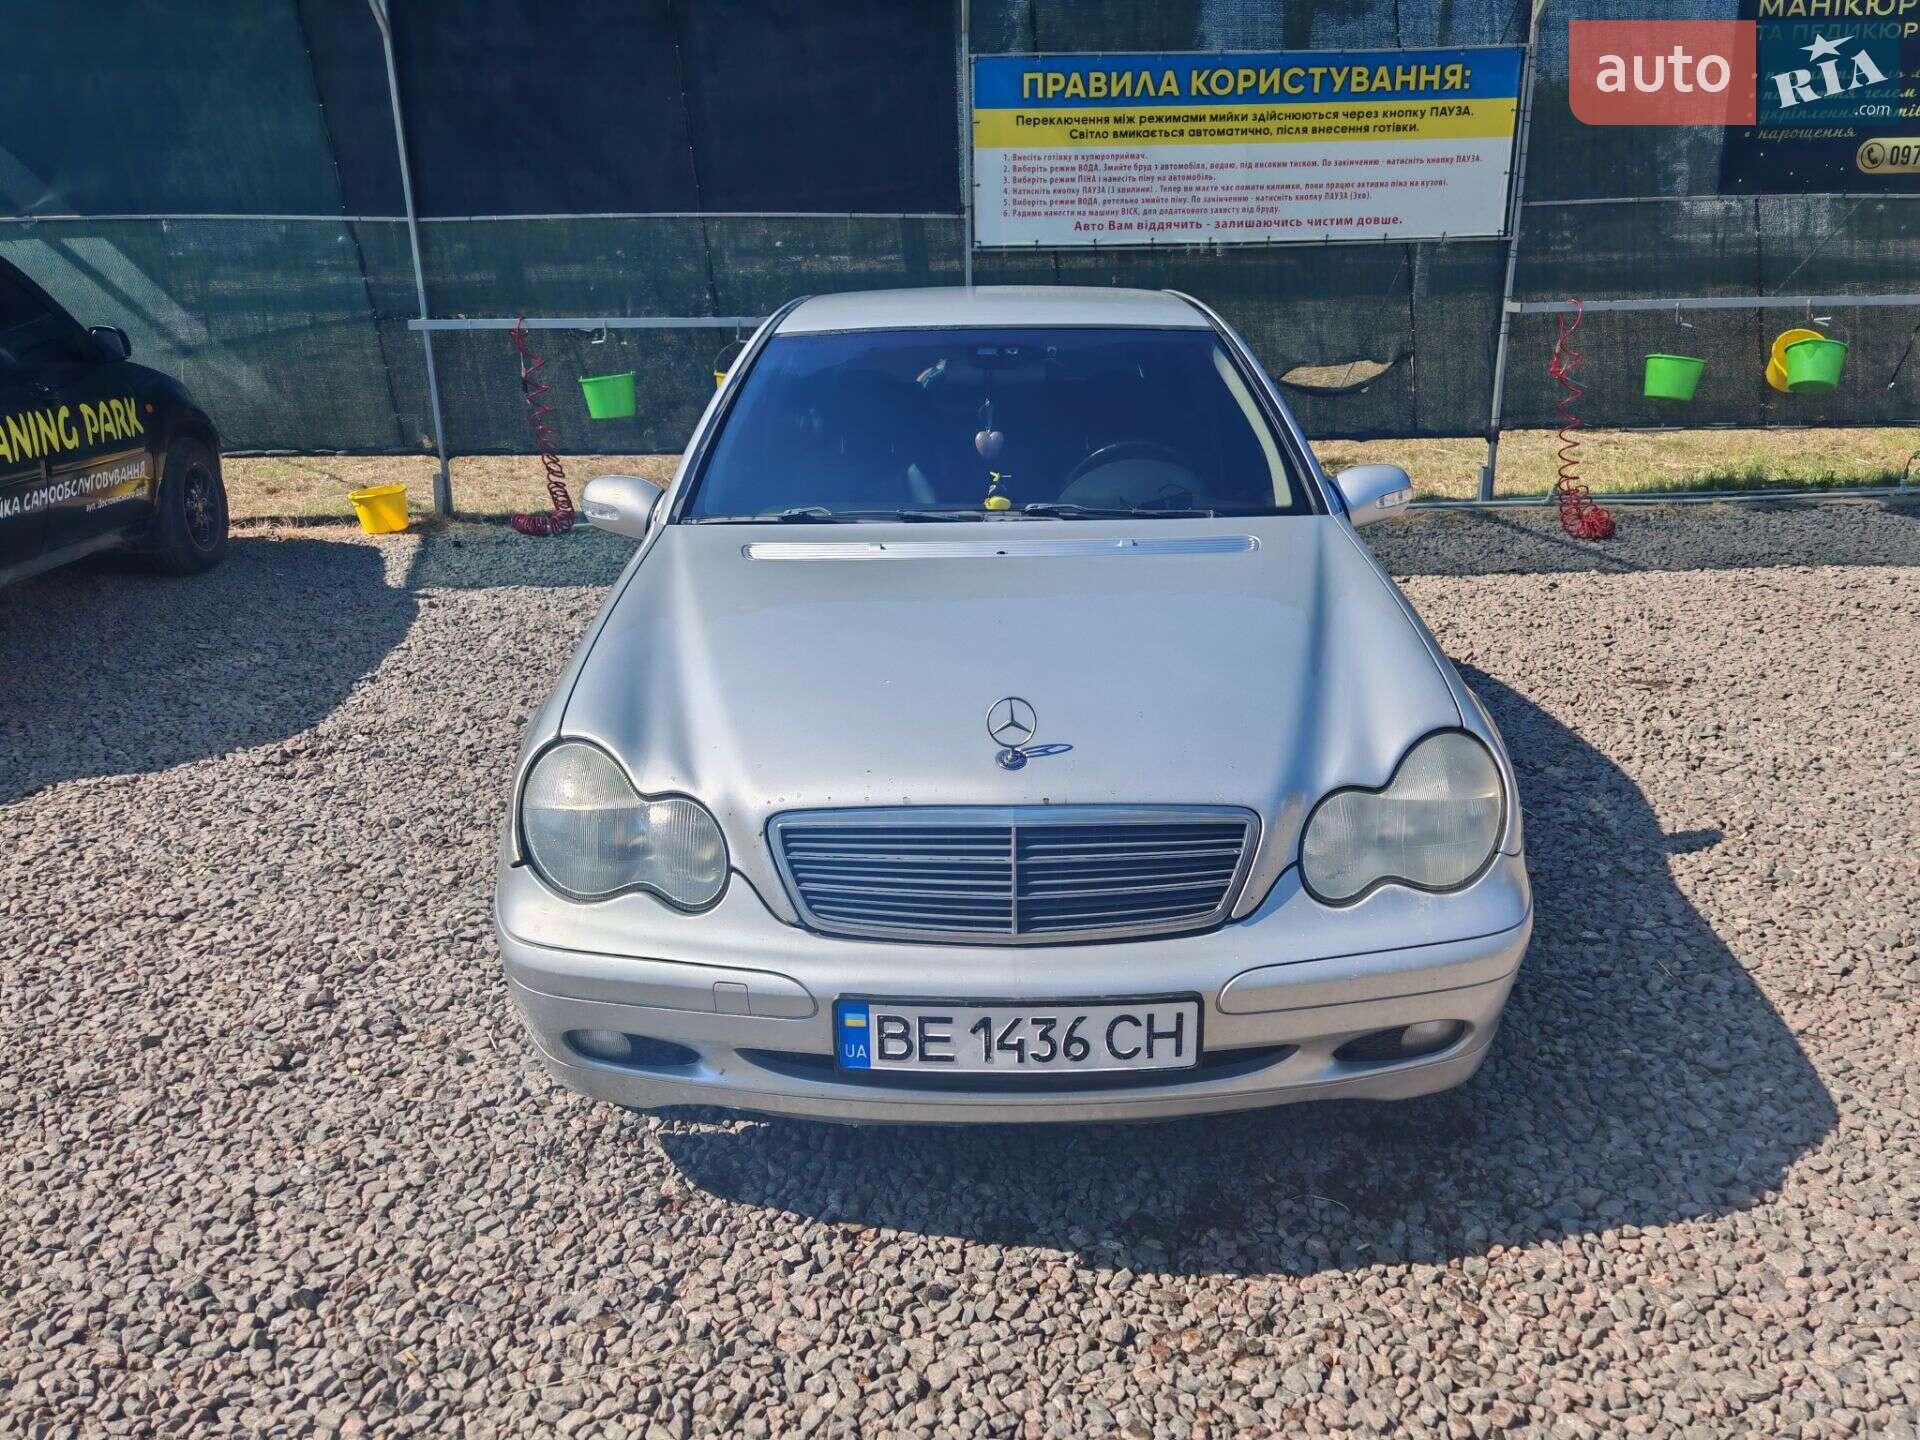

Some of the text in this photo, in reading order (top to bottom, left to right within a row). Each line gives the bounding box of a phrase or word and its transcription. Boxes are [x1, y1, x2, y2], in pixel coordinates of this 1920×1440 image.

[1758, 0, 1919, 17] МАНІКЮР
[1022, 63, 1472, 99] ПРАВИЛА КОРИСТУВАННЯ:
[1015, 105, 1474, 128] Переключення між режимами мийки здійснюються через кнопку ПАУЗА.
[1069, 121, 1420, 140] Світло вмикається автоматично, після внесення готівки.
[1757, 128, 1857, 143] нарощення
[1889, 145, 1920, 165] 097
[1073, 221, 1105, 231] Авто
[1108, 219, 1133, 231] Вам
[1136, 220, 1203, 232] віддячить
[1215, 218, 1304, 229] залишаючись
[1306, 217, 1354, 227] чистим
[1356, 216, 1403, 227] довше.
[79, 397, 145, 447] PARK
[23, 461, 146, 512] САМООБСЛУГОВУВАННЯ
[845, 1010, 1184, 1064] UA BE 1436 CH
